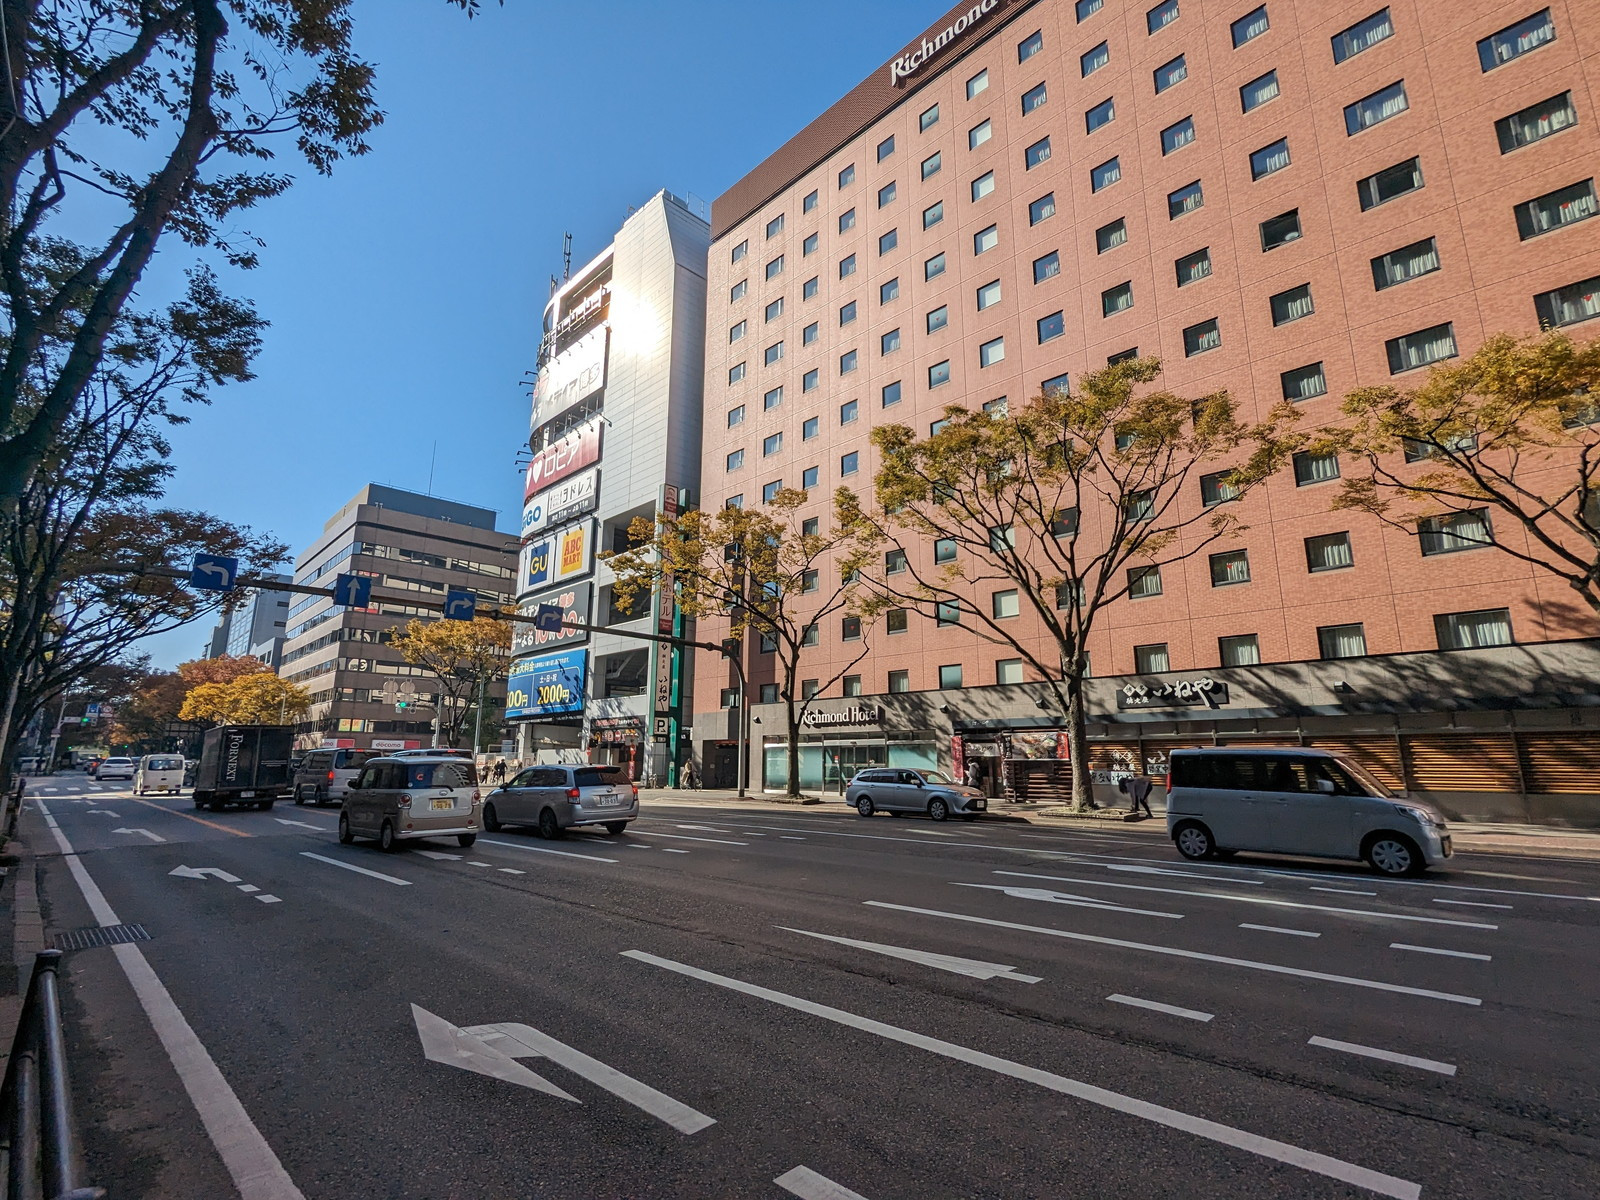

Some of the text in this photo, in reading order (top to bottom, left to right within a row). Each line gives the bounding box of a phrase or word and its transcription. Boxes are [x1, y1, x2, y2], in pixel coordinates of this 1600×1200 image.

[544, 441, 581, 478] ロピア
[564, 536, 582, 556] ABC
[531, 553, 548, 575] GU
[563, 552, 581, 568] MART
[1153, 677, 1214, 707] いねや
[801, 705, 879, 725] Richmond Hotel
[657, 720, 666, 733] P
[375, 741, 401, 749] docomo
[226, 734, 243, 782] FORNEXT
